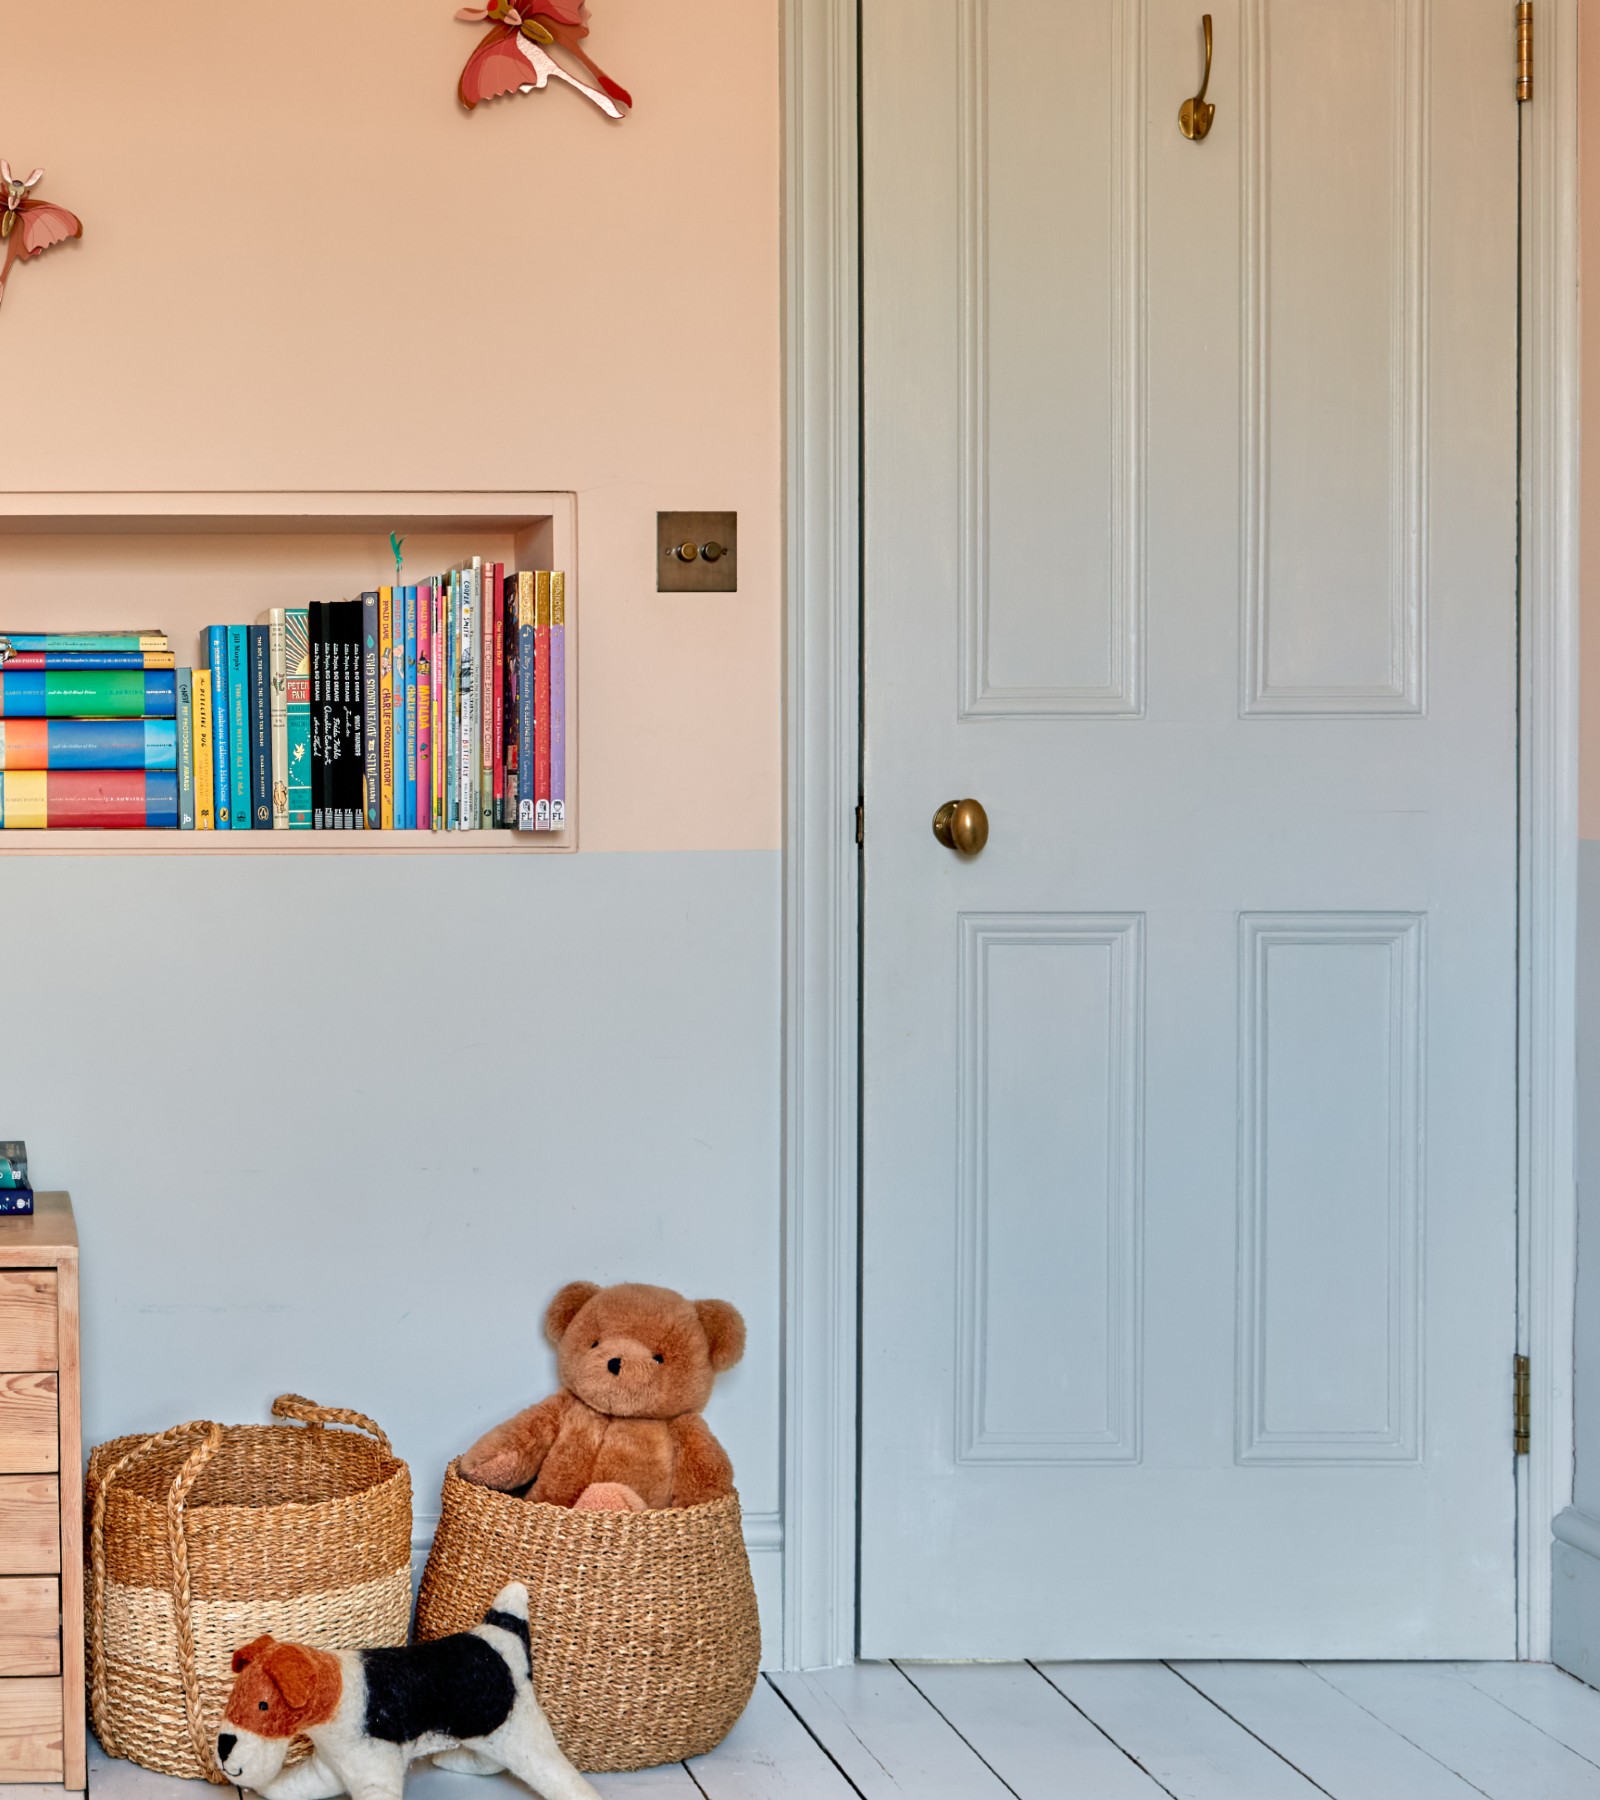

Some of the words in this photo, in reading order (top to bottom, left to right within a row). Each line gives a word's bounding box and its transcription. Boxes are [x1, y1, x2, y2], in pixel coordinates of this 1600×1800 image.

[366, 653, 374, 676] GIRLS
[288, 682, 309, 690] PETER
[292, 691, 306, 699] PAN
[407, 684, 415, 711] CHARLIE
[367, 679, 377, 737] ADVENTUROUS
[382, 688, 391, 719] CHARLIE
[394, 694, 403, 708] BFG
[419, 685, 429, 730] MATILDA
[218, 706, 226, 740] Ambrose
[238, 772, 243, 780] AT
[367, 754, 377, 778] TALES
